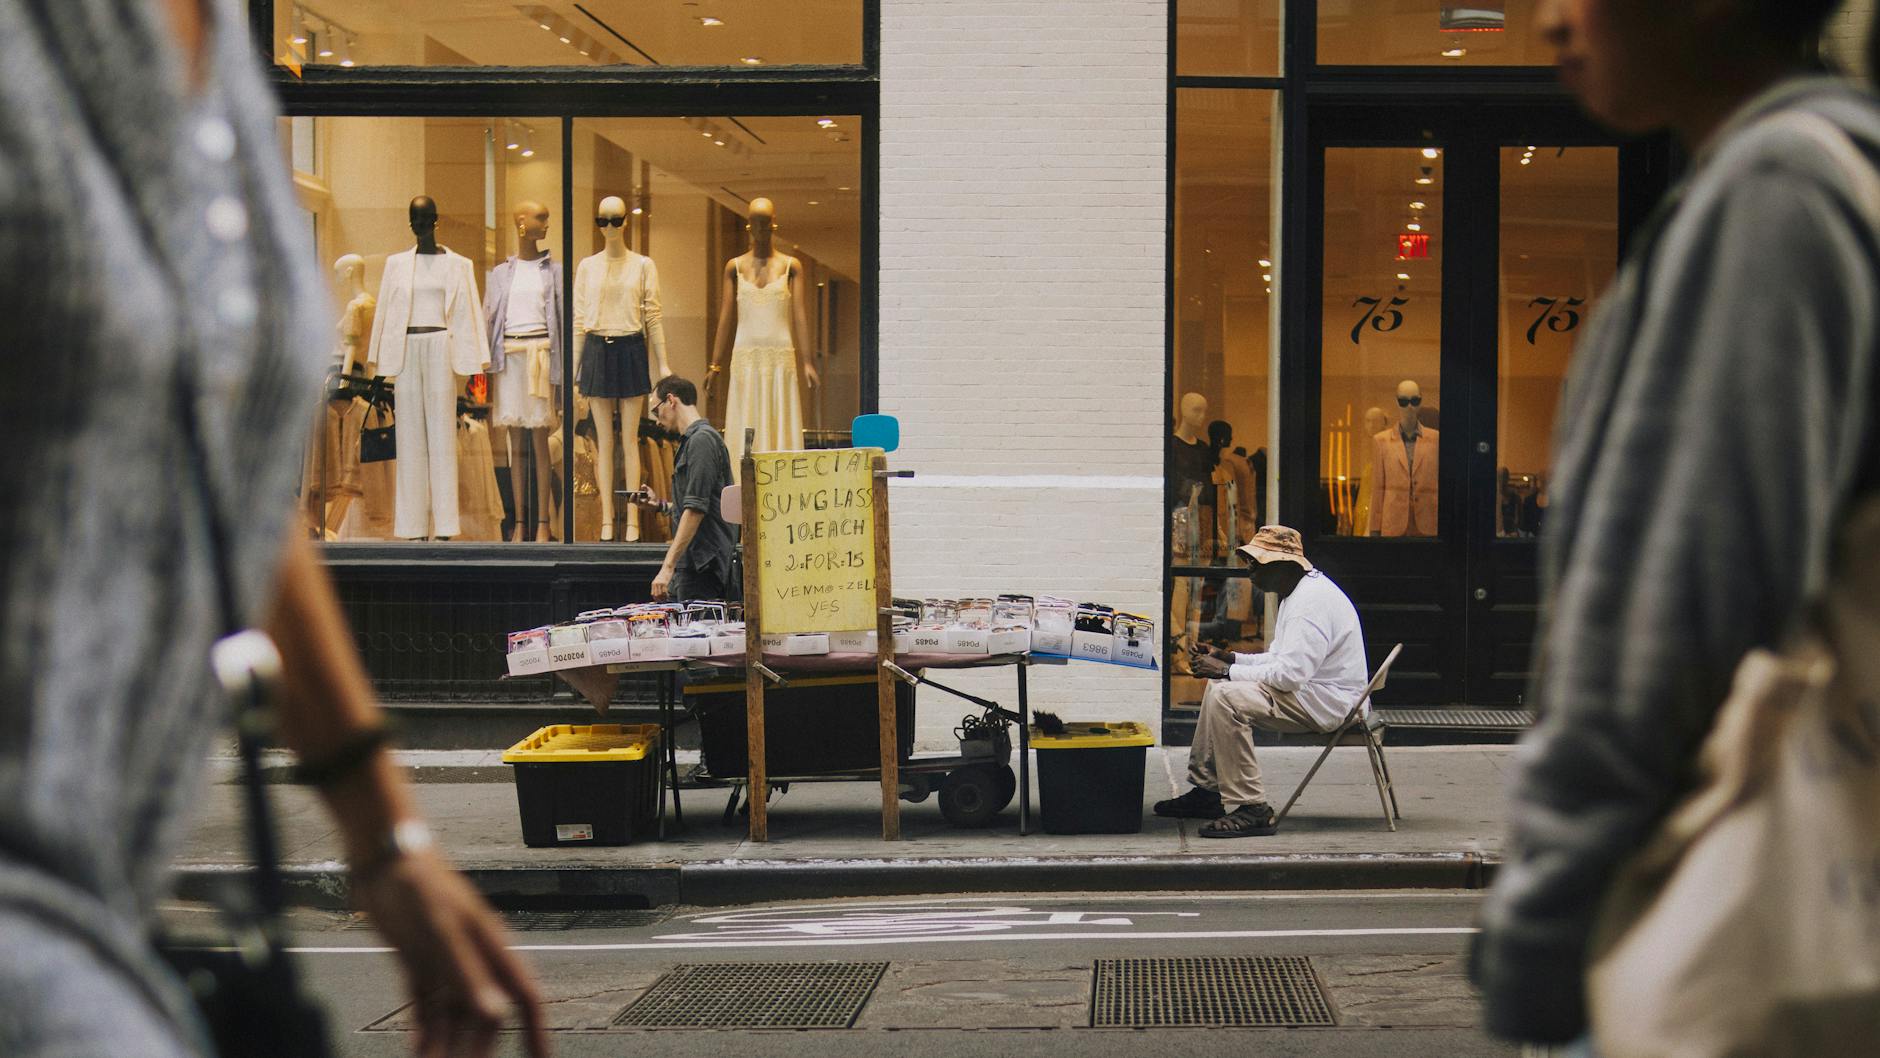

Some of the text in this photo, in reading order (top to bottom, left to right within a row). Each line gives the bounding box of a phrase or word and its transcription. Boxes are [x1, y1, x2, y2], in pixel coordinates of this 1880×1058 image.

[1399, 235, 1429, 257] EXIT
[1351, 296, 1409, 344] 75
[1527, 296, 1585, 344] 75
[756, 452, 872, 486] SPECIAL
[761, 488, 872, 522] SUNGLASS
[808, 600, 840, 617] YES
[915, 638, 939, 646] P0485
[957, 639, 980, 648] P0485
[1082, 642, 1108, 655] 9863
[1121, 648, 1144, 659] P0485
